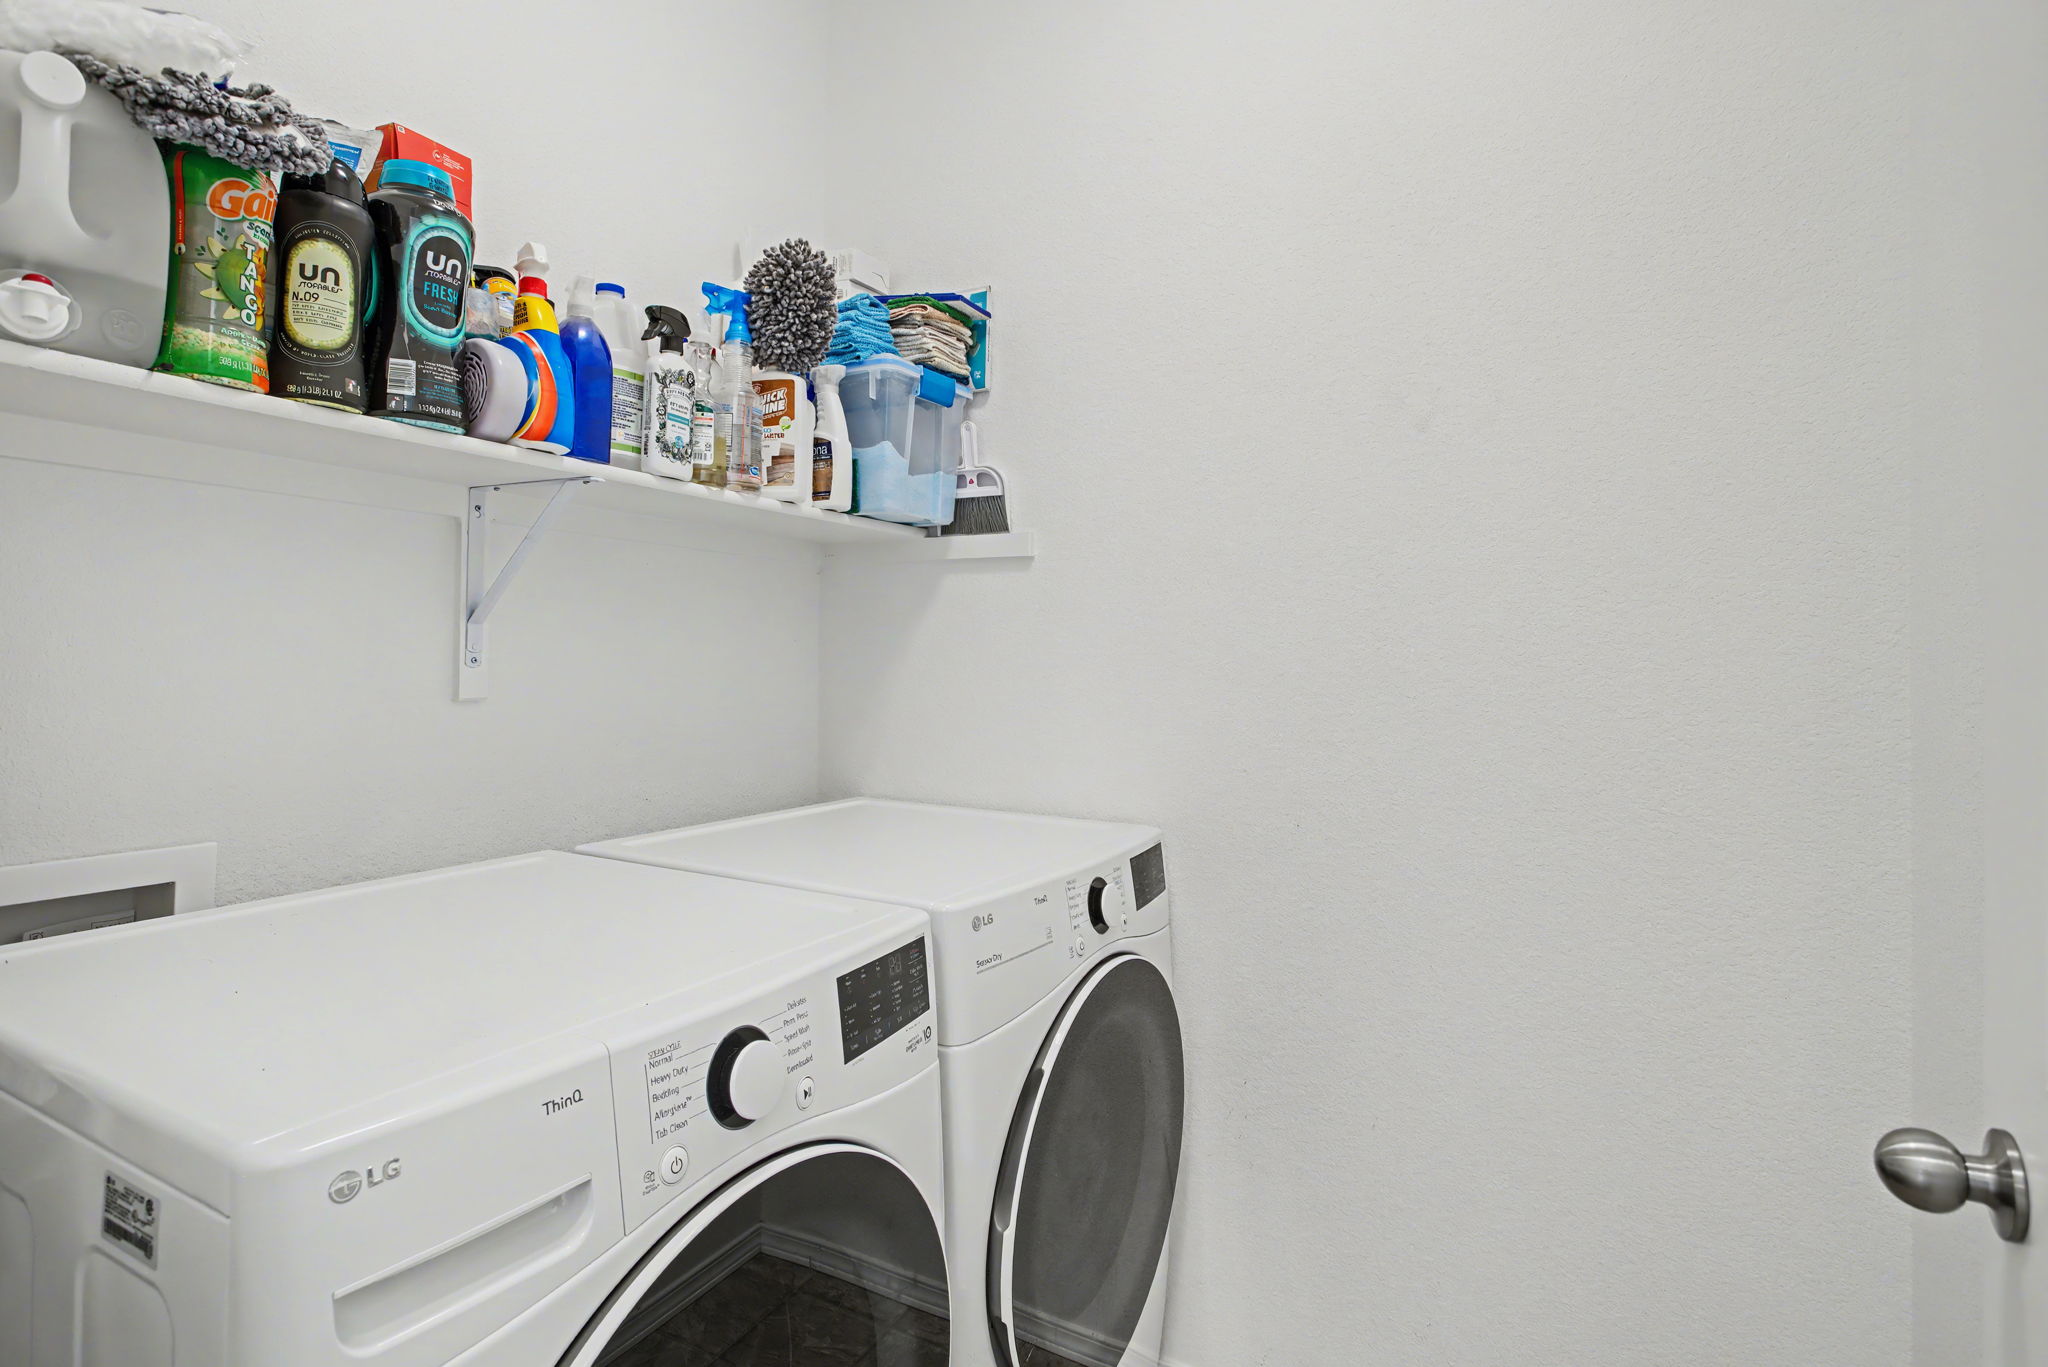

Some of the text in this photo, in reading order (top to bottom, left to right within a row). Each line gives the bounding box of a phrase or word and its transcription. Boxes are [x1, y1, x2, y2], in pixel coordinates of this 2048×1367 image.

[207, 178, 277, 222] Gai
[240, 241, 258, 327] TANGO
[423, 281, 459, 306] FRESH
[763, 400, 786, 415] INE
[813, 445, 828, 455] ona
[648, 1053, 674, 1069] Normal
[650, 1066, 689, 1086] Heavy Duty
[542, 1088, 584, 1116] ThinQ
[669, 1119, 689, 1134] Clean
[366, 1157, 401, 1189] LG
